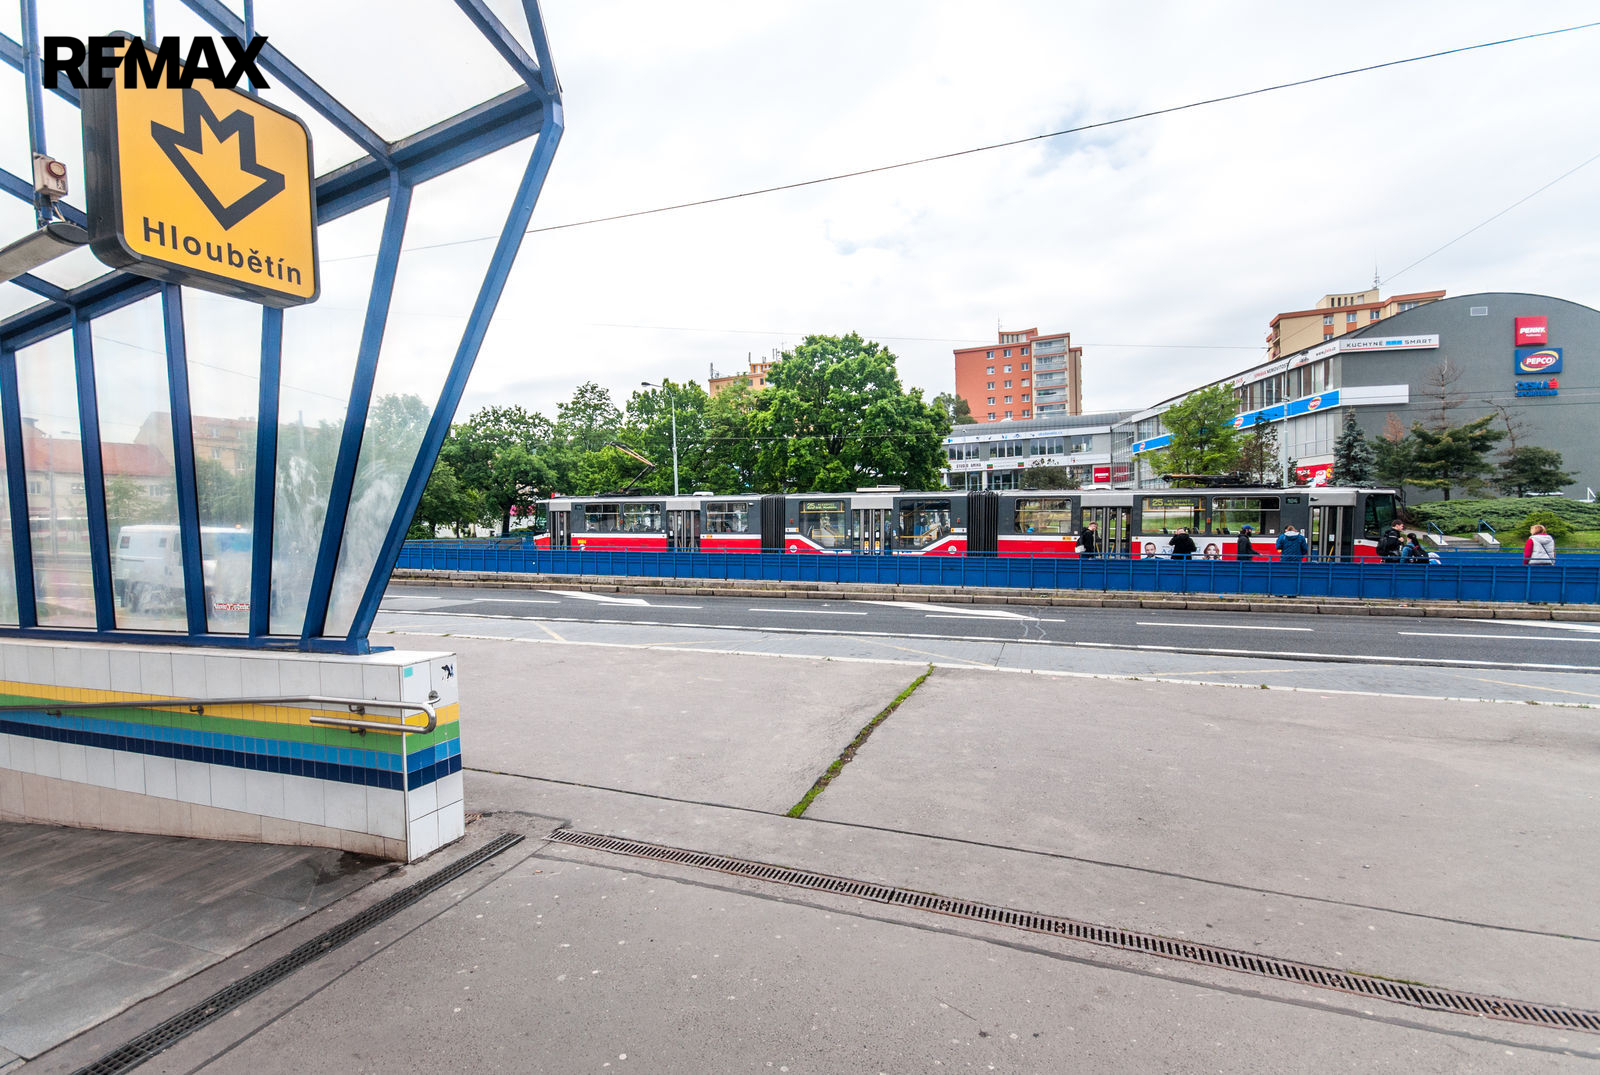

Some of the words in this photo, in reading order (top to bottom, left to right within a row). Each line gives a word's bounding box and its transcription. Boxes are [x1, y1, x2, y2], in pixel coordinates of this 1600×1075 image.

[143, 216, 302, 285] Hloubětín
[1526, 357, 1553, 365] PEPCO
[807, 502, 816, 510] 25
[1152, 498, 1163, 506] 25
